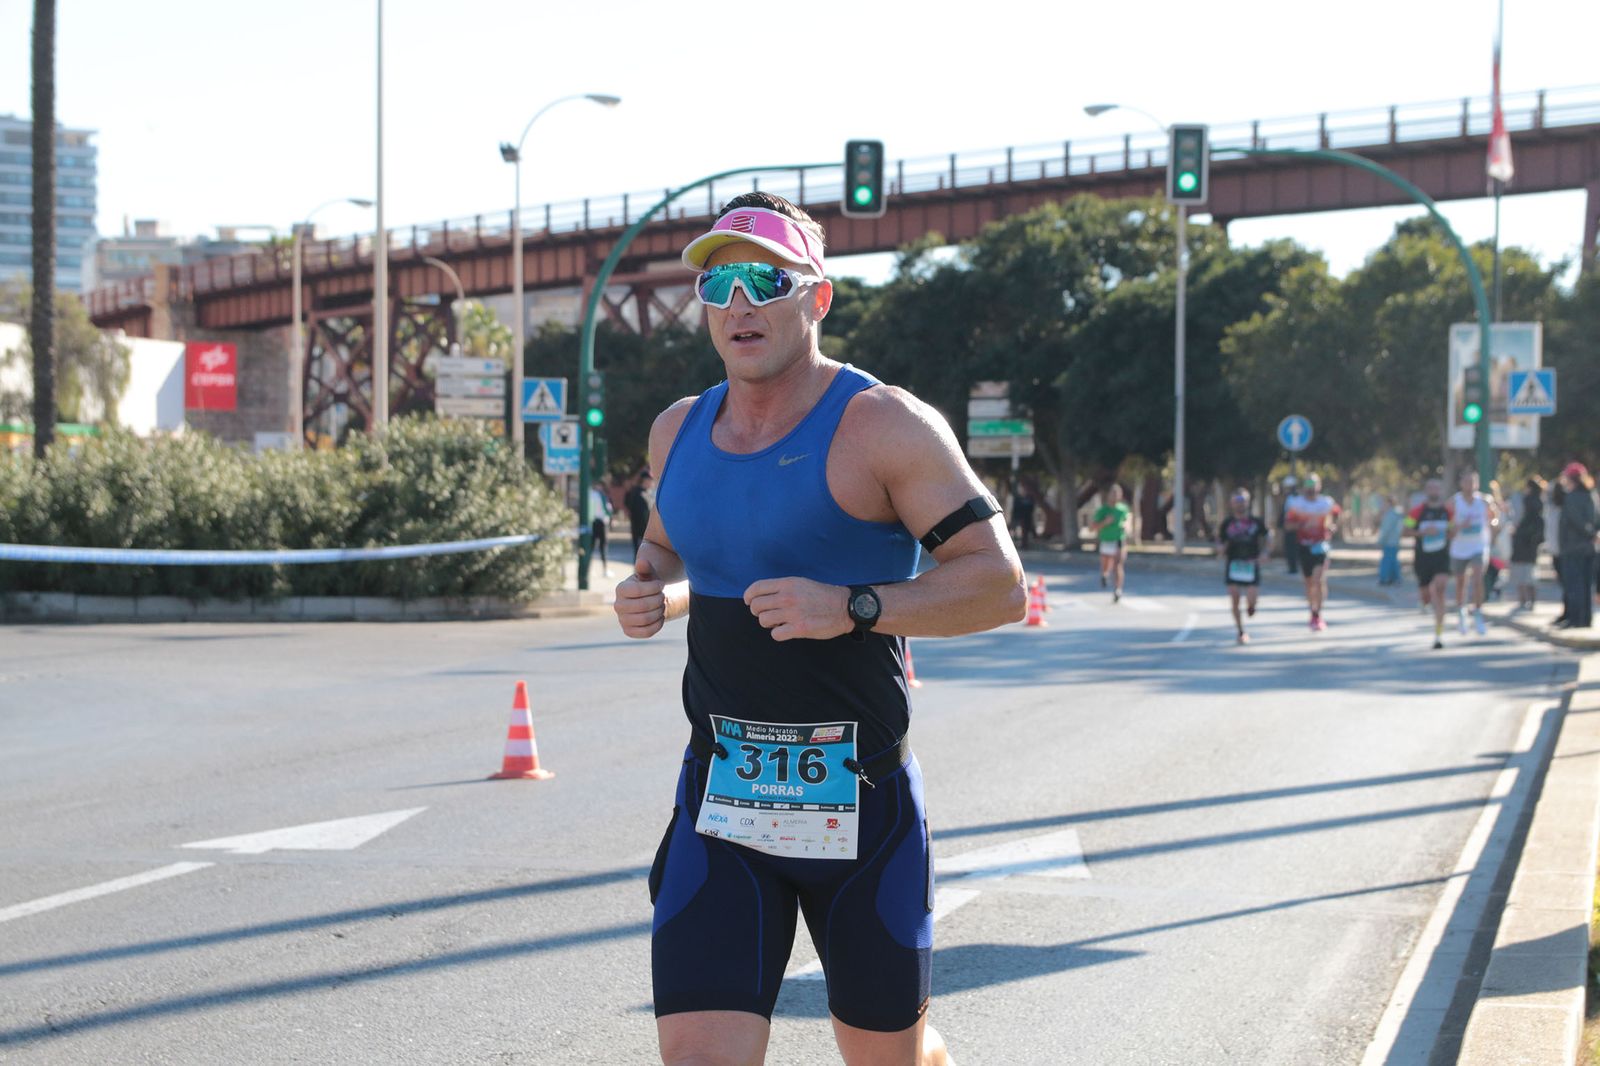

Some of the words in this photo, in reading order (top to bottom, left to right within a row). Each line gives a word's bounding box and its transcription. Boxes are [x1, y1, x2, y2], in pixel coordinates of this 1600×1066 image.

[746, 725, 767, 733] Medio
[746, 731, 776, 741] Almería
[776, 733, 798, 743] 2022
[735, 743, 829, 785] 316
[752, 783, 804, 796] PORRAS
[708, 814, 728, 824] NEXA
